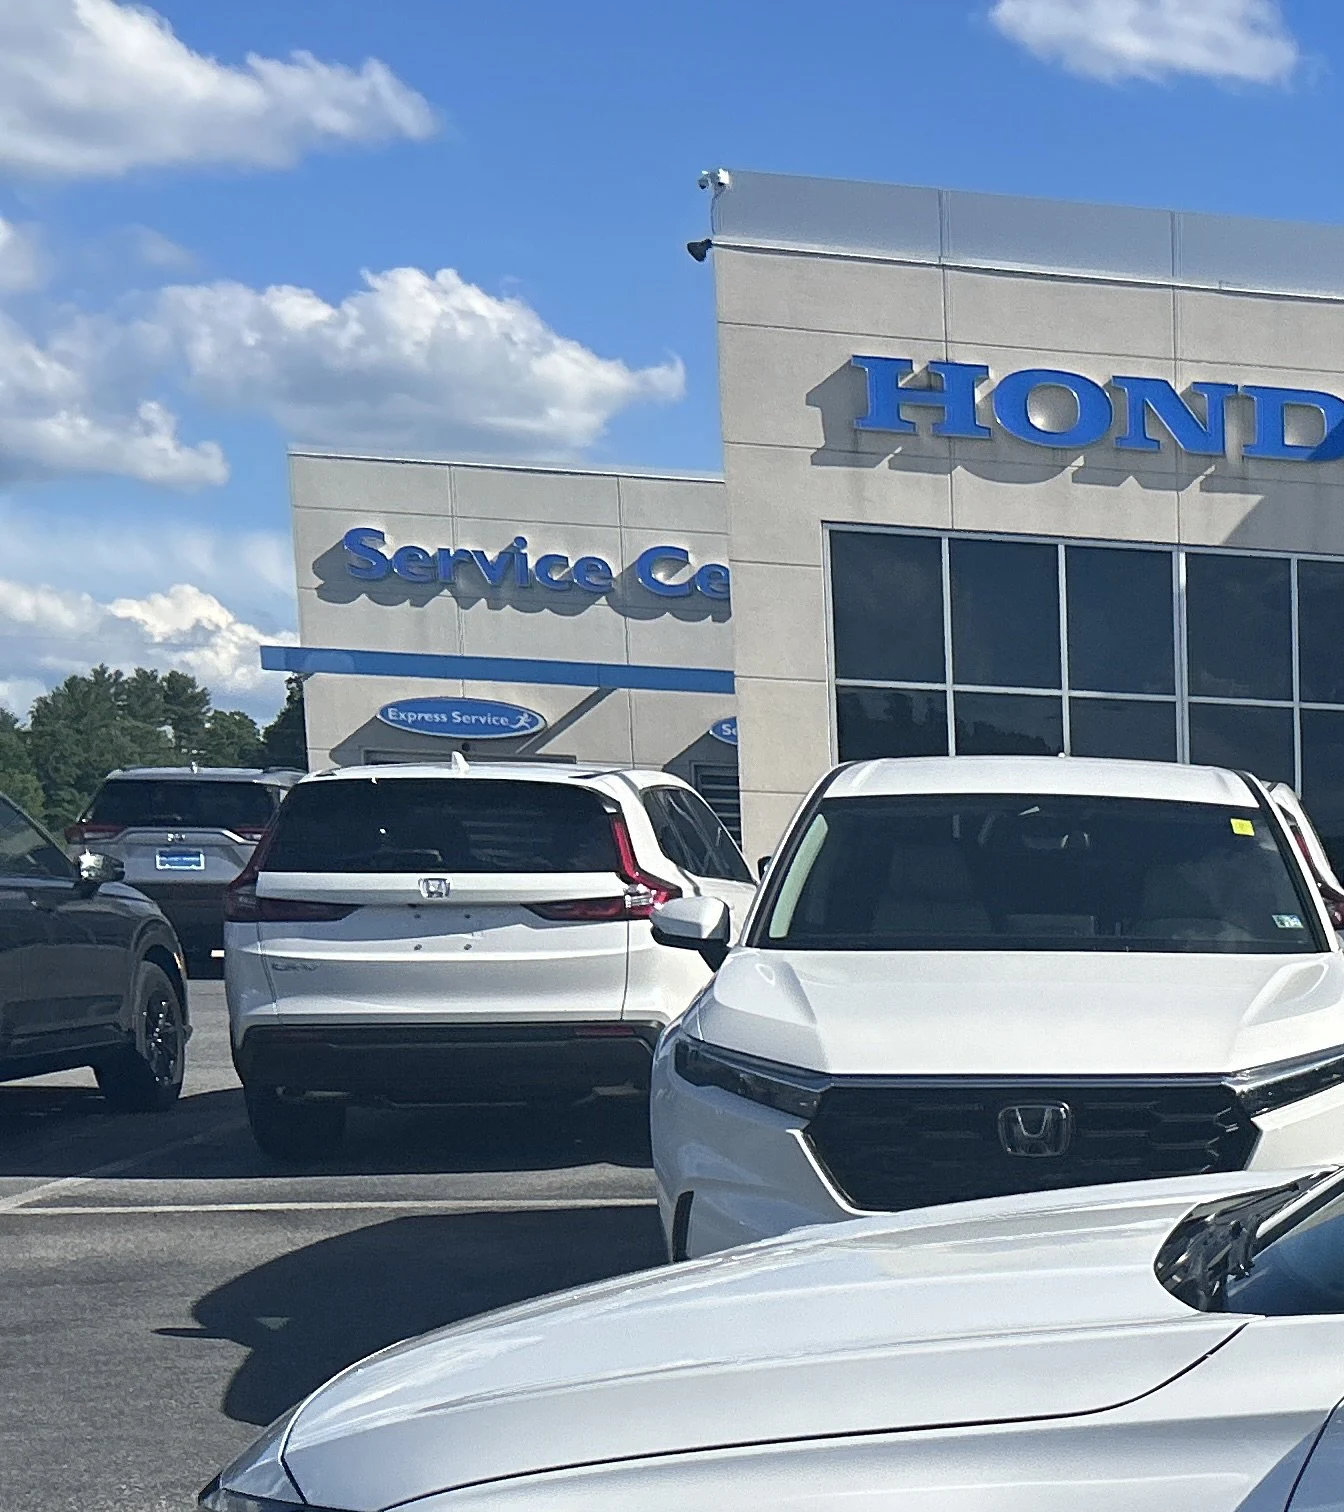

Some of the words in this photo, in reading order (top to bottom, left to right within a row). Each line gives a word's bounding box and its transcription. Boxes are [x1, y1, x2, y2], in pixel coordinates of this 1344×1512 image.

[342, 527, 614, 594] Service
[387, 707, 448, 724] Express
[451, 711, 509, 726] Service
